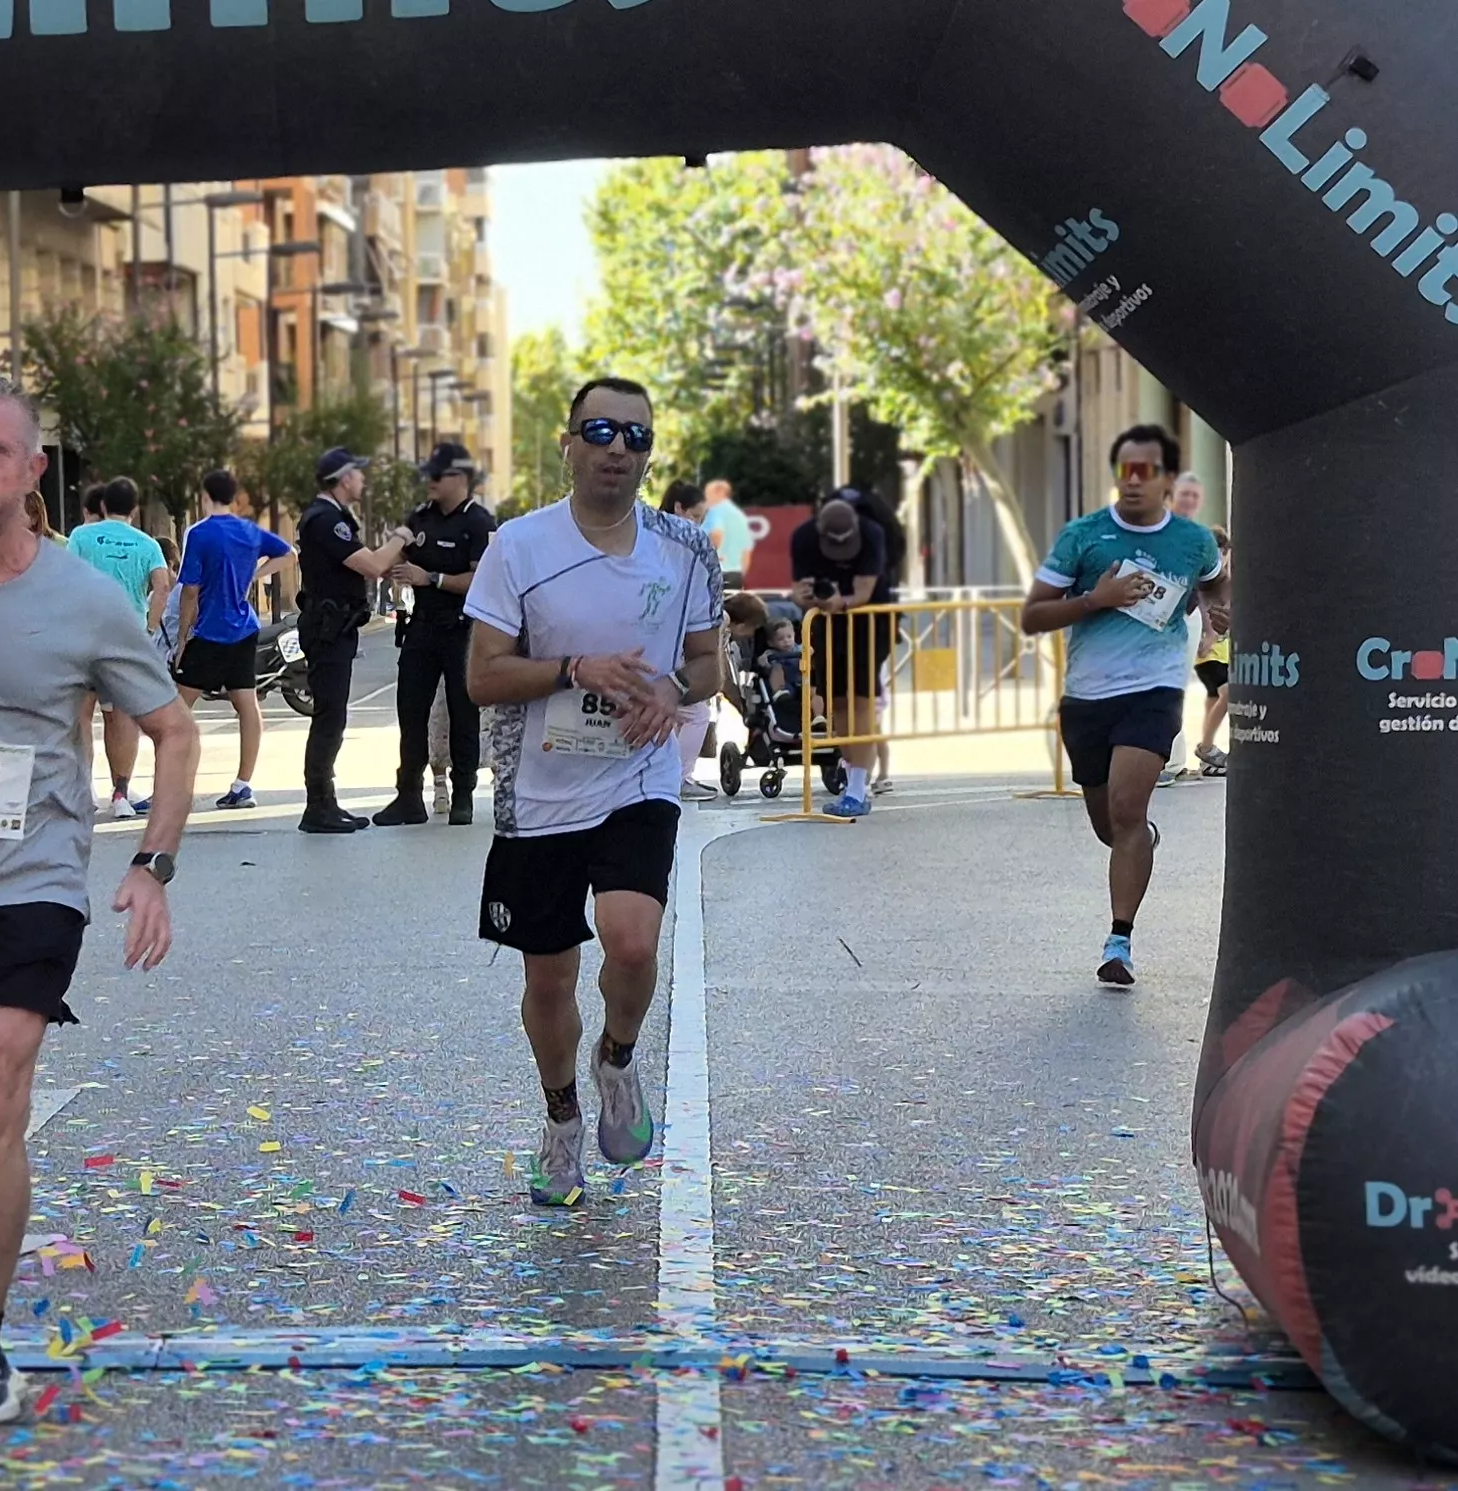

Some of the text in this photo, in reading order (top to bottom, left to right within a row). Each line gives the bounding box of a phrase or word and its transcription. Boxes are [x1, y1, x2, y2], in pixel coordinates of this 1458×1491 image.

[1388, 691, 1458, 709] Servicio
[1259, 705, 1267, 720] y
[585, 718, 612, 729] JUAN
[1379, 714, 1444, 734] gestión
